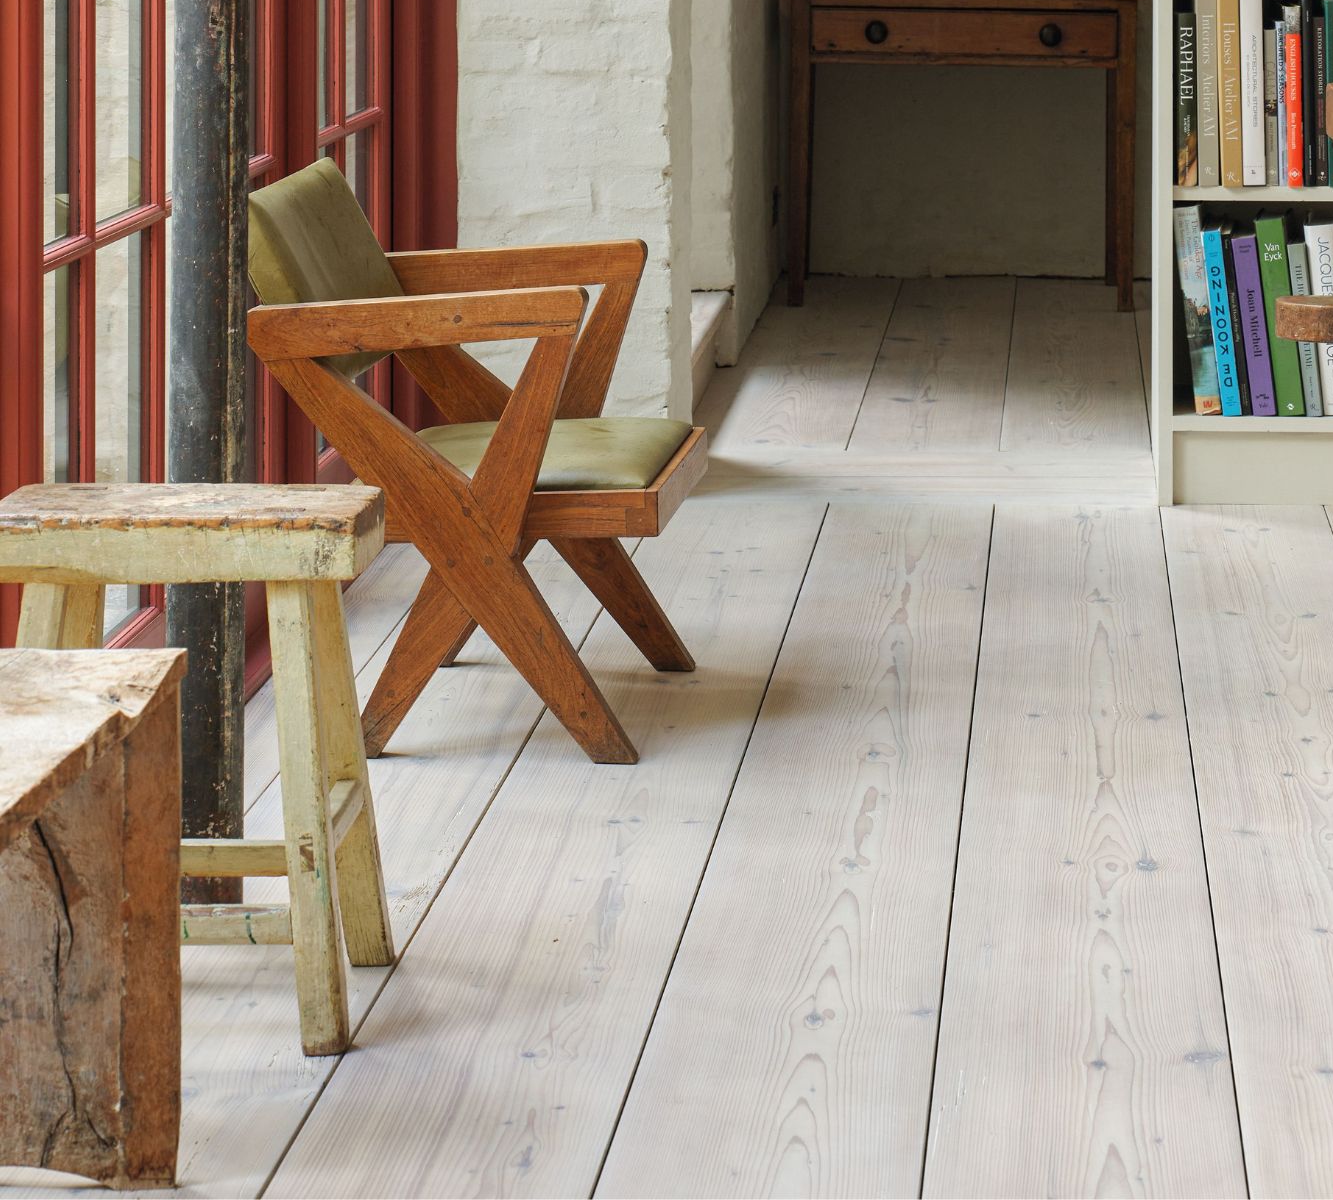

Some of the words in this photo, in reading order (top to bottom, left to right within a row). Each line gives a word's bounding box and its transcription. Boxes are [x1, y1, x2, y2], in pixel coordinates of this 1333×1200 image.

[1202, 14, 1213, 64] Interiors
[1223, 23, 1235, 64] Houses
[1179, 27, 1193, 105] RAPHAEL
[1202, 72, 1214, 112] Atelier
[1224, 76, 1236, 115] Atelier
[1204, 114, 1215, 136] AM
[1225, 117, 1237, 140] AM
[1264, 243, 1280, 251] Van
[1264, 253, 1282, 262] Eyck
[1210, 266, 1229, 355] KOONING
[1246, 288, 1257, 312] Joan
[1250, 315, 1263, 357] Mitchell
[1224, 364, 1233, 387] DE
